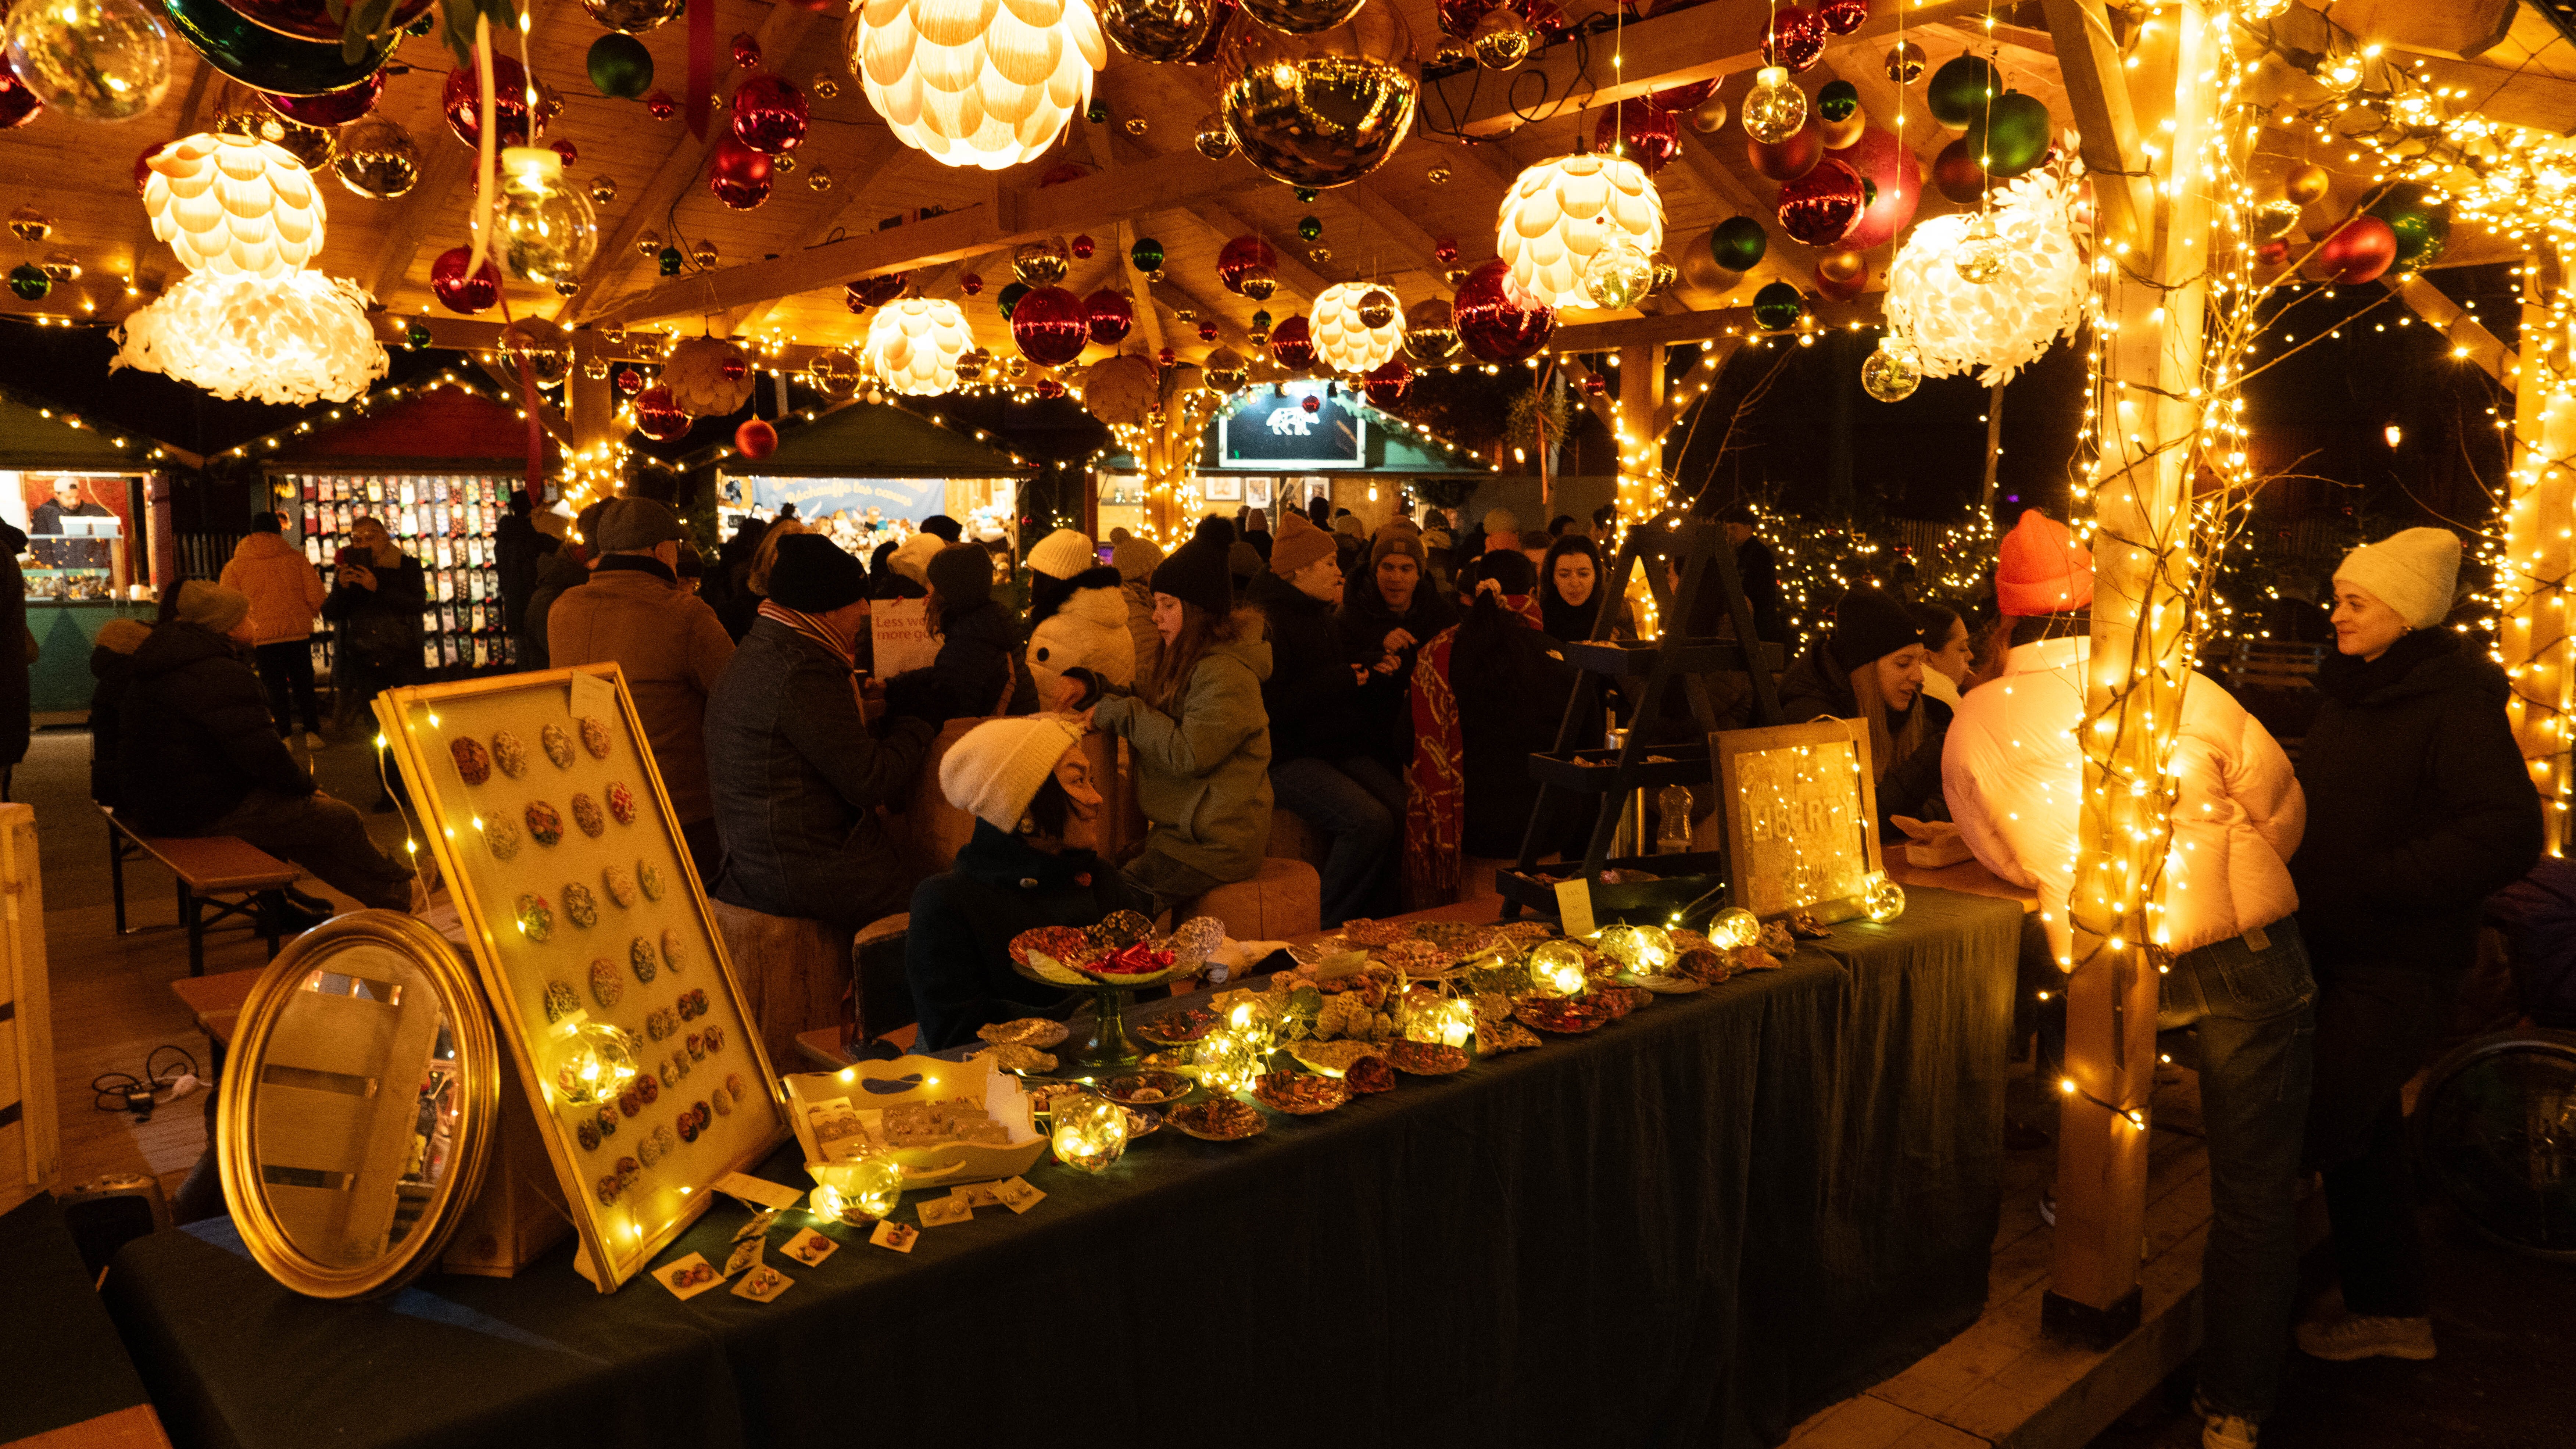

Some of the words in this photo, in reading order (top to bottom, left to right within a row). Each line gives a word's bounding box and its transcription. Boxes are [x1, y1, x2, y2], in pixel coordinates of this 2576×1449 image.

[785, 480, 852, 504] Réchauffe
[853, 481, 873, 495] les
[876, 617, 904, 627] Less
[907, 618, 926, 626] wo
[877, 630, 911, 640] more
[914, 630, 930, 642] go
